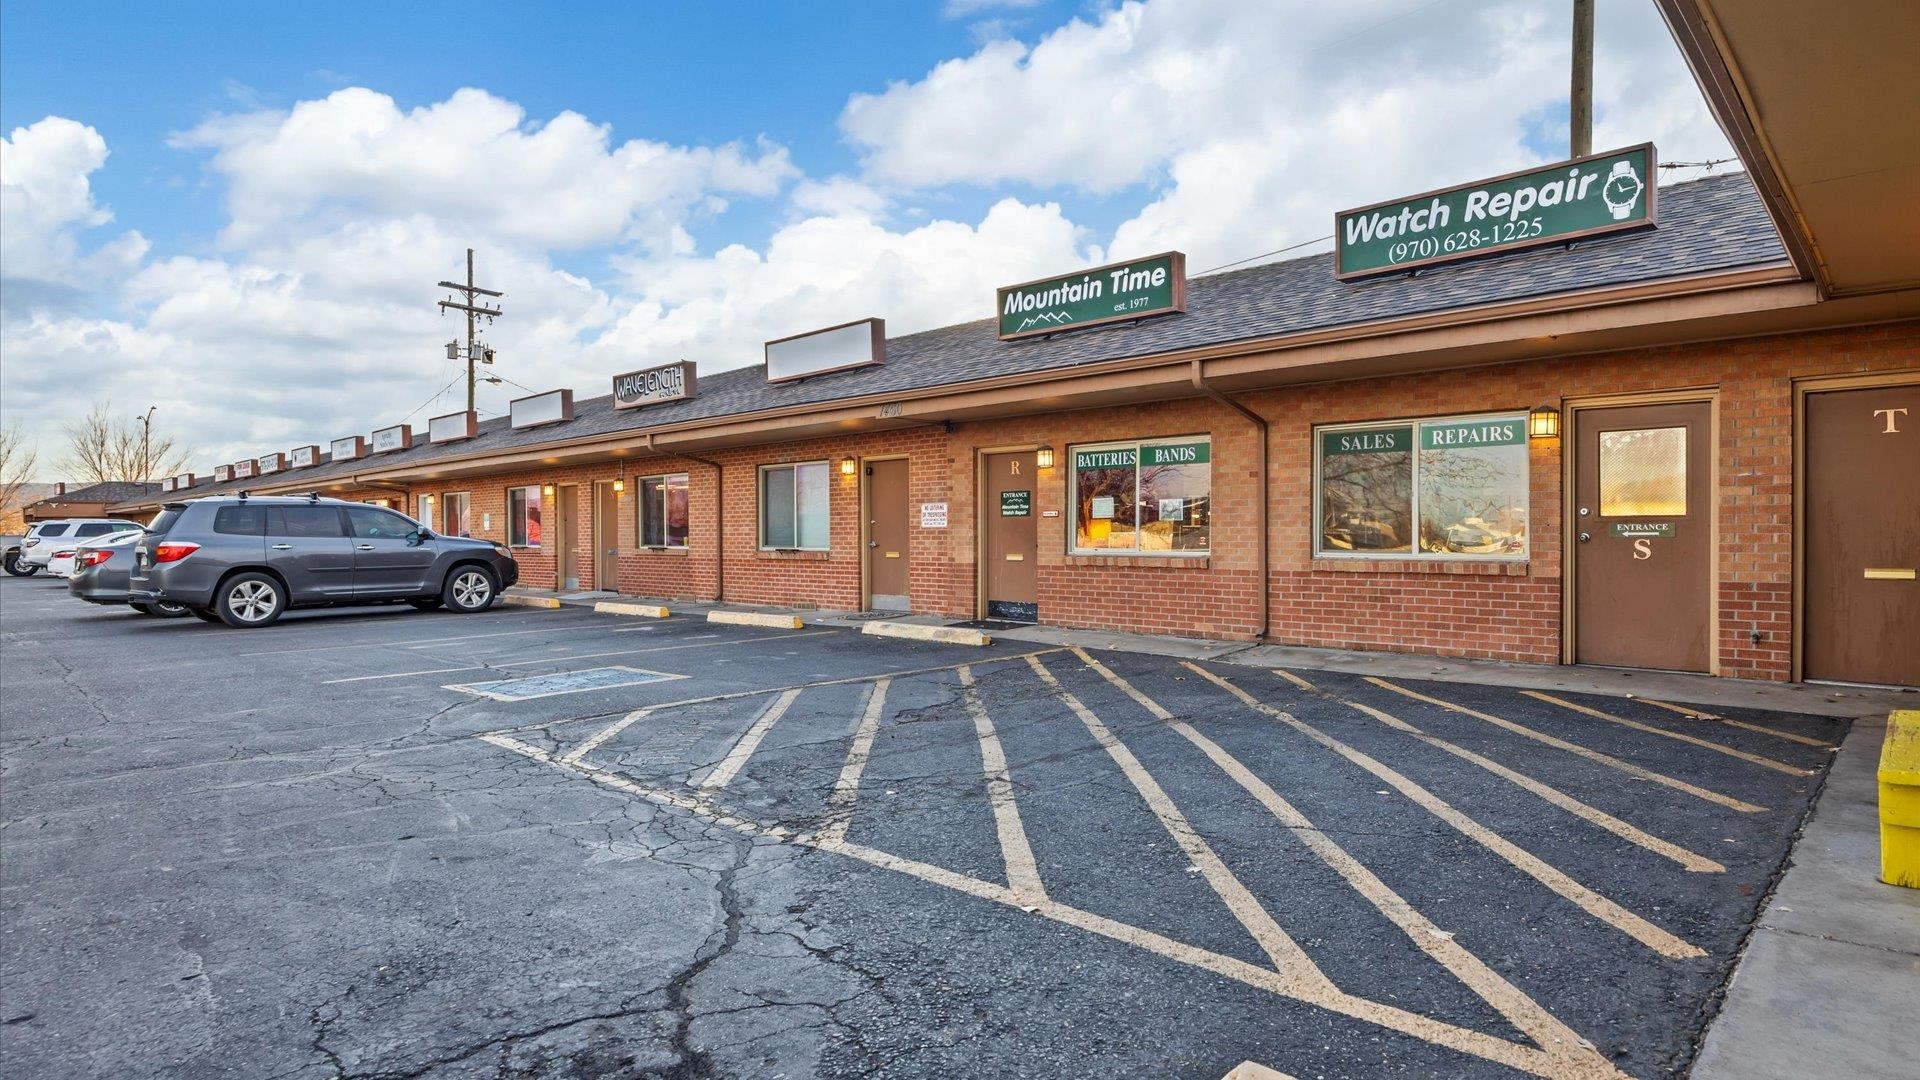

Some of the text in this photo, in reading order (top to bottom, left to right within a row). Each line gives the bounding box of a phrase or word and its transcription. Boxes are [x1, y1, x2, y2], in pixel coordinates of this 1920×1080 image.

[1346, 168, 1598, 246] Watch Repair
[1388, 217, 1543, 264] (970) 628-1225
[1003, 267, 1167, 315] Mountain Time
[1114, 297, 1150, 311] est. 1977
[616, 365, 682, 400] WAVELENGTH
[1873, 407, 1908, 434] T
[1340, 433, 1395, 451] SALES
[1432, 425, 1514, 445] REPAIRS
[1077, 451, 1137, 468] BATTERIES
[1155, 446, 1196, 463] BANDS
[1010, 460, 1021, 475] R
[1002, 491, 1028, 499] ENTRANCE
[1616, 523, 1669, 531] ENTRANCE
[1633, 538, 1652, 560] S
